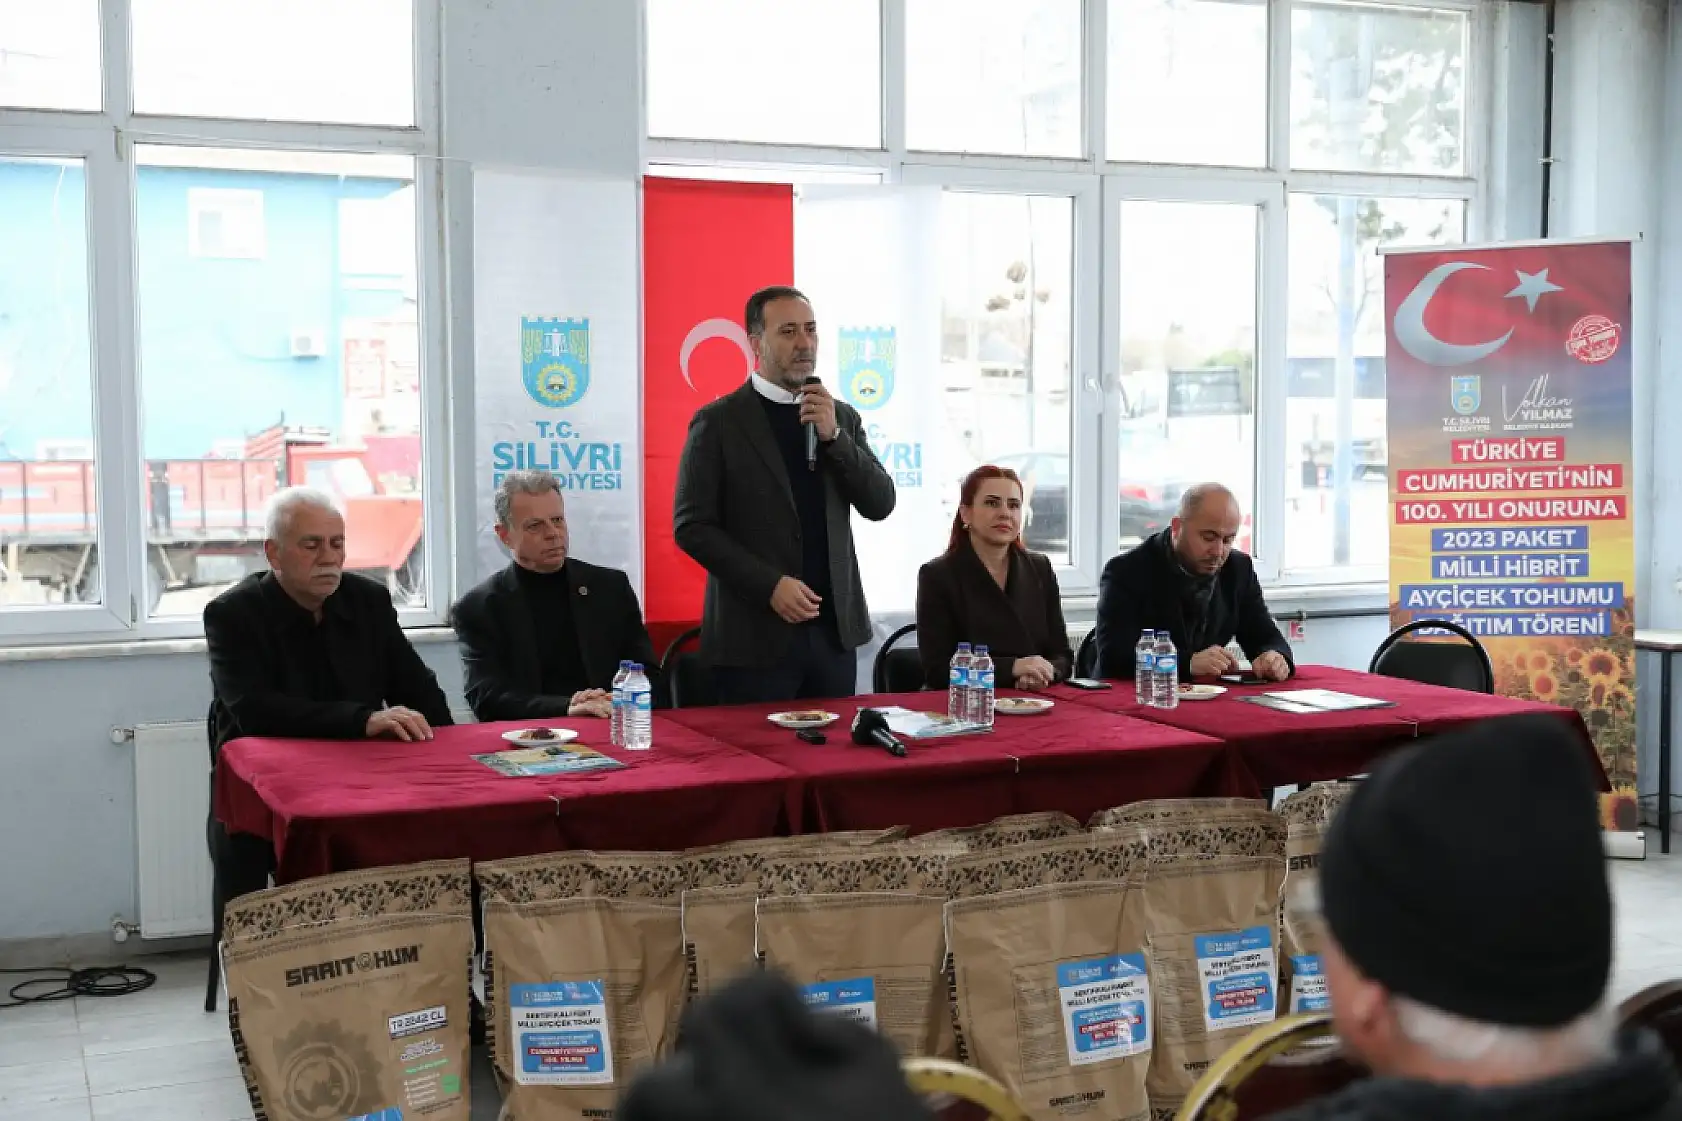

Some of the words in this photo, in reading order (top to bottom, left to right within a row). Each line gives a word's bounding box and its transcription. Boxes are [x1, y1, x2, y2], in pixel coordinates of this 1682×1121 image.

[1522, 408, 1573, 420] YILMAZ
[536, 421, 580, 439] T.C.
[493, 442, 622, 471] SİLİVRİ
[1458, 437, 1557, 461] TÜRKİYE
[493, 473, 622, 490] BDİYESİ
[1405, 465, 1613, 491] CUMHURİYETİ'NİN
[1401, 504, 1447, 521] 100.
[1453, 502, 1493, 519] YILI
[1499, 499, 1619, 518] ONURUNA
[1442, 531, 1497, 548] 2023
[1501, 529, 1577, 547] PAKET
[1439, 555, 1499, 578] MİLLİ
[1505, 553, 1580, 576] HİBRİT
[1408, 584, 1507, 609] AYÇİÇEK
[1511, 588, 1614, 606] TOHUMU
[1518, 612, 1605, 635] TÖRENİ
